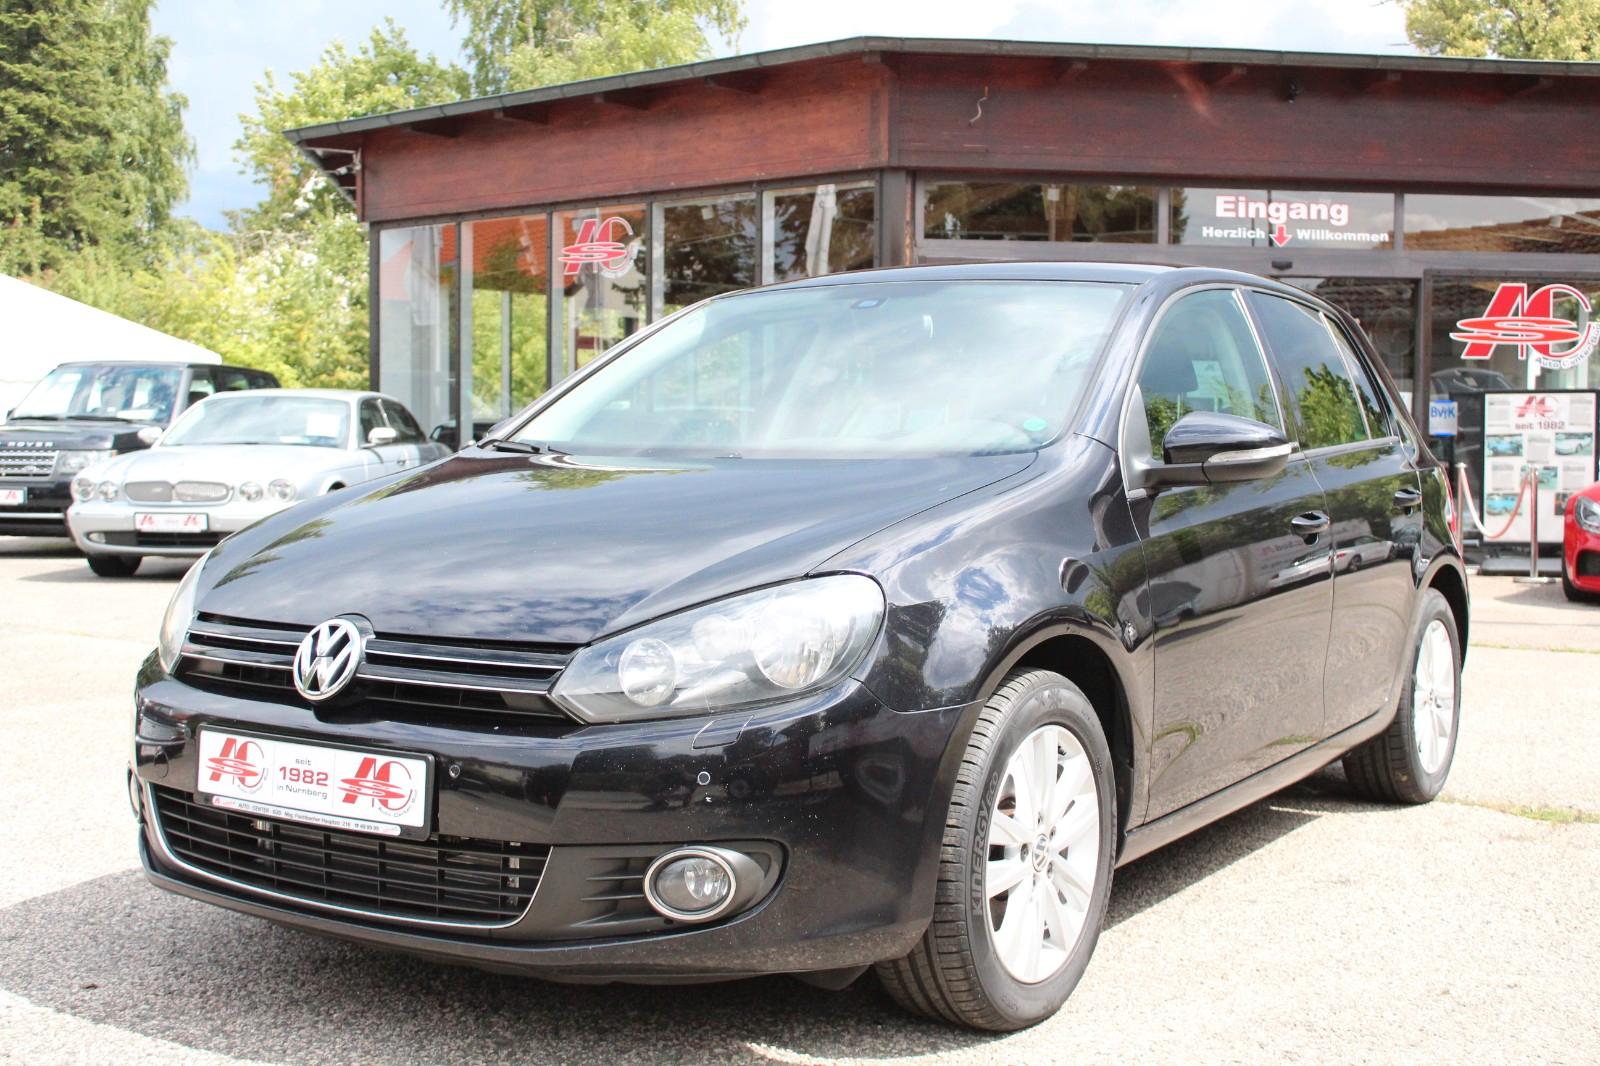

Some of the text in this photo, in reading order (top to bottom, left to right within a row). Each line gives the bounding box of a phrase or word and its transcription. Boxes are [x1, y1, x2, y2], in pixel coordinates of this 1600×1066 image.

[1215, 195, 1349, 226] Eingang
[1202, 226, 1389, 242] Herzlich Willkommen
[295, 758, 312, 766] seit
[279, 766, 329, 787] 1982
[971, 799, 990, 917] KINERGY
